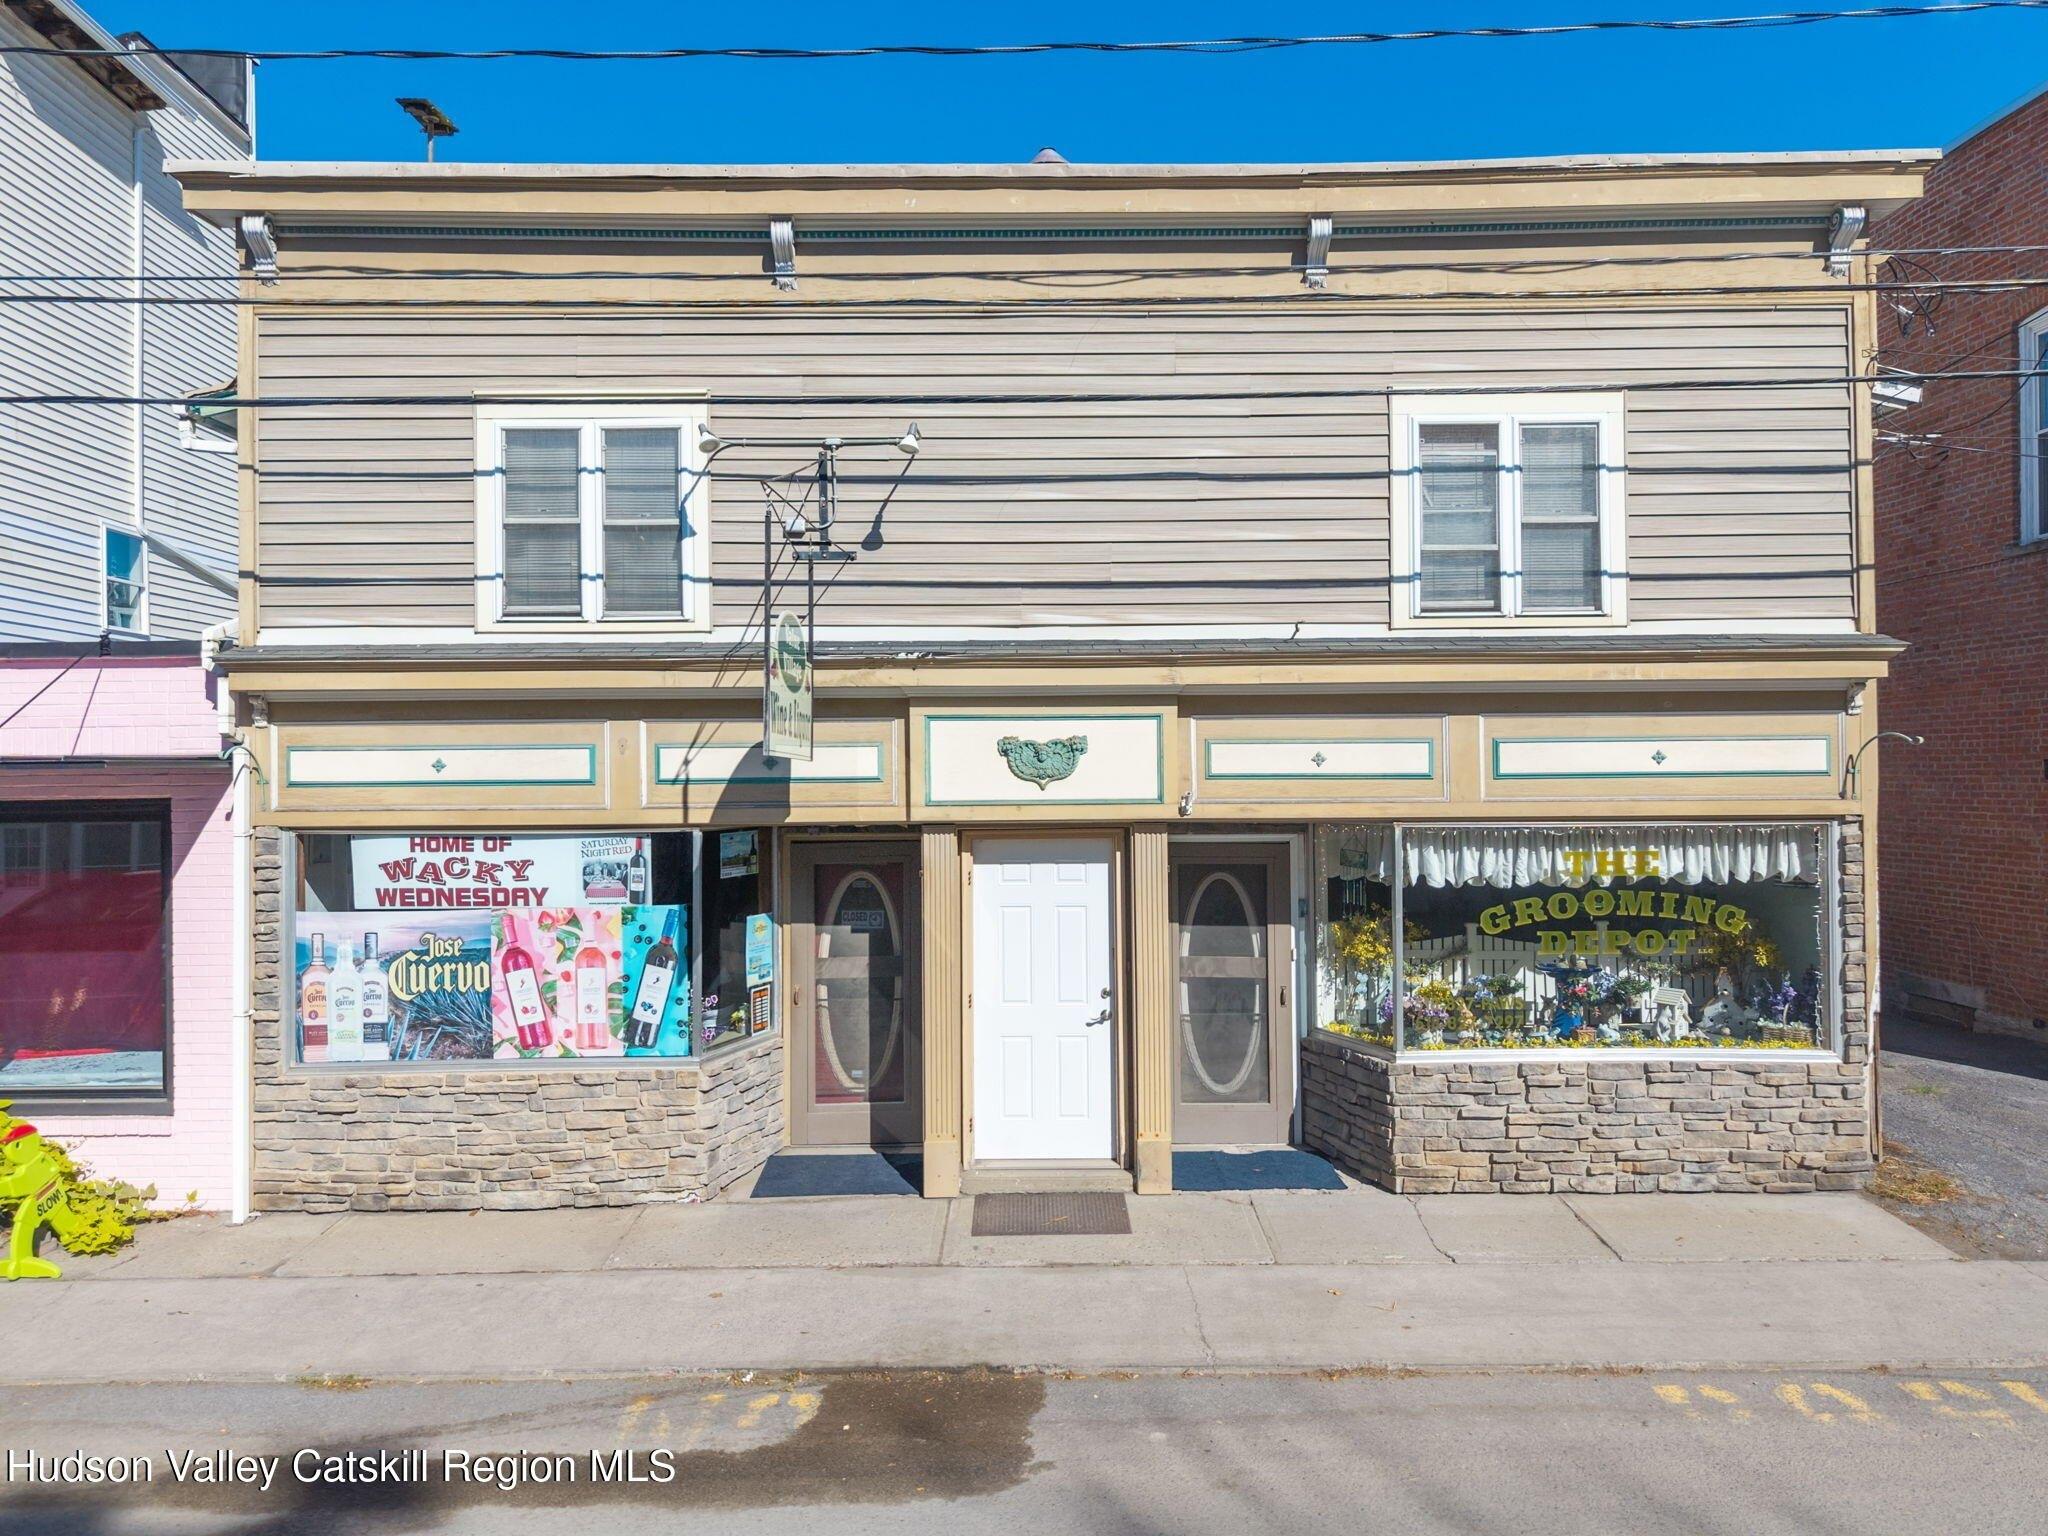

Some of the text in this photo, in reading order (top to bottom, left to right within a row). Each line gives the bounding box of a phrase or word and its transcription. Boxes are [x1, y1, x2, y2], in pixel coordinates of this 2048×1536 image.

[770, 691, 787, 735] Wine
[409, 836, 512, 853] HOME OF
[581, 836, 628, 849] SATURDAY
[581, 845, 632, 858] NIGHT RED
[378, 856, 535, 886] WACKY
[1564, 850, 1660, 876] THE
[375, 887, 550, 907] WEDNESDAY
[1479, 889, 1748, 935] GROOMING
[420, 932, 464, 963] Jose
[1536, 929, 1697, 956] DEPOT
[388, 950, 491, 1002] Cuervo
[37, 1189, 63, 1217] SLOW!
